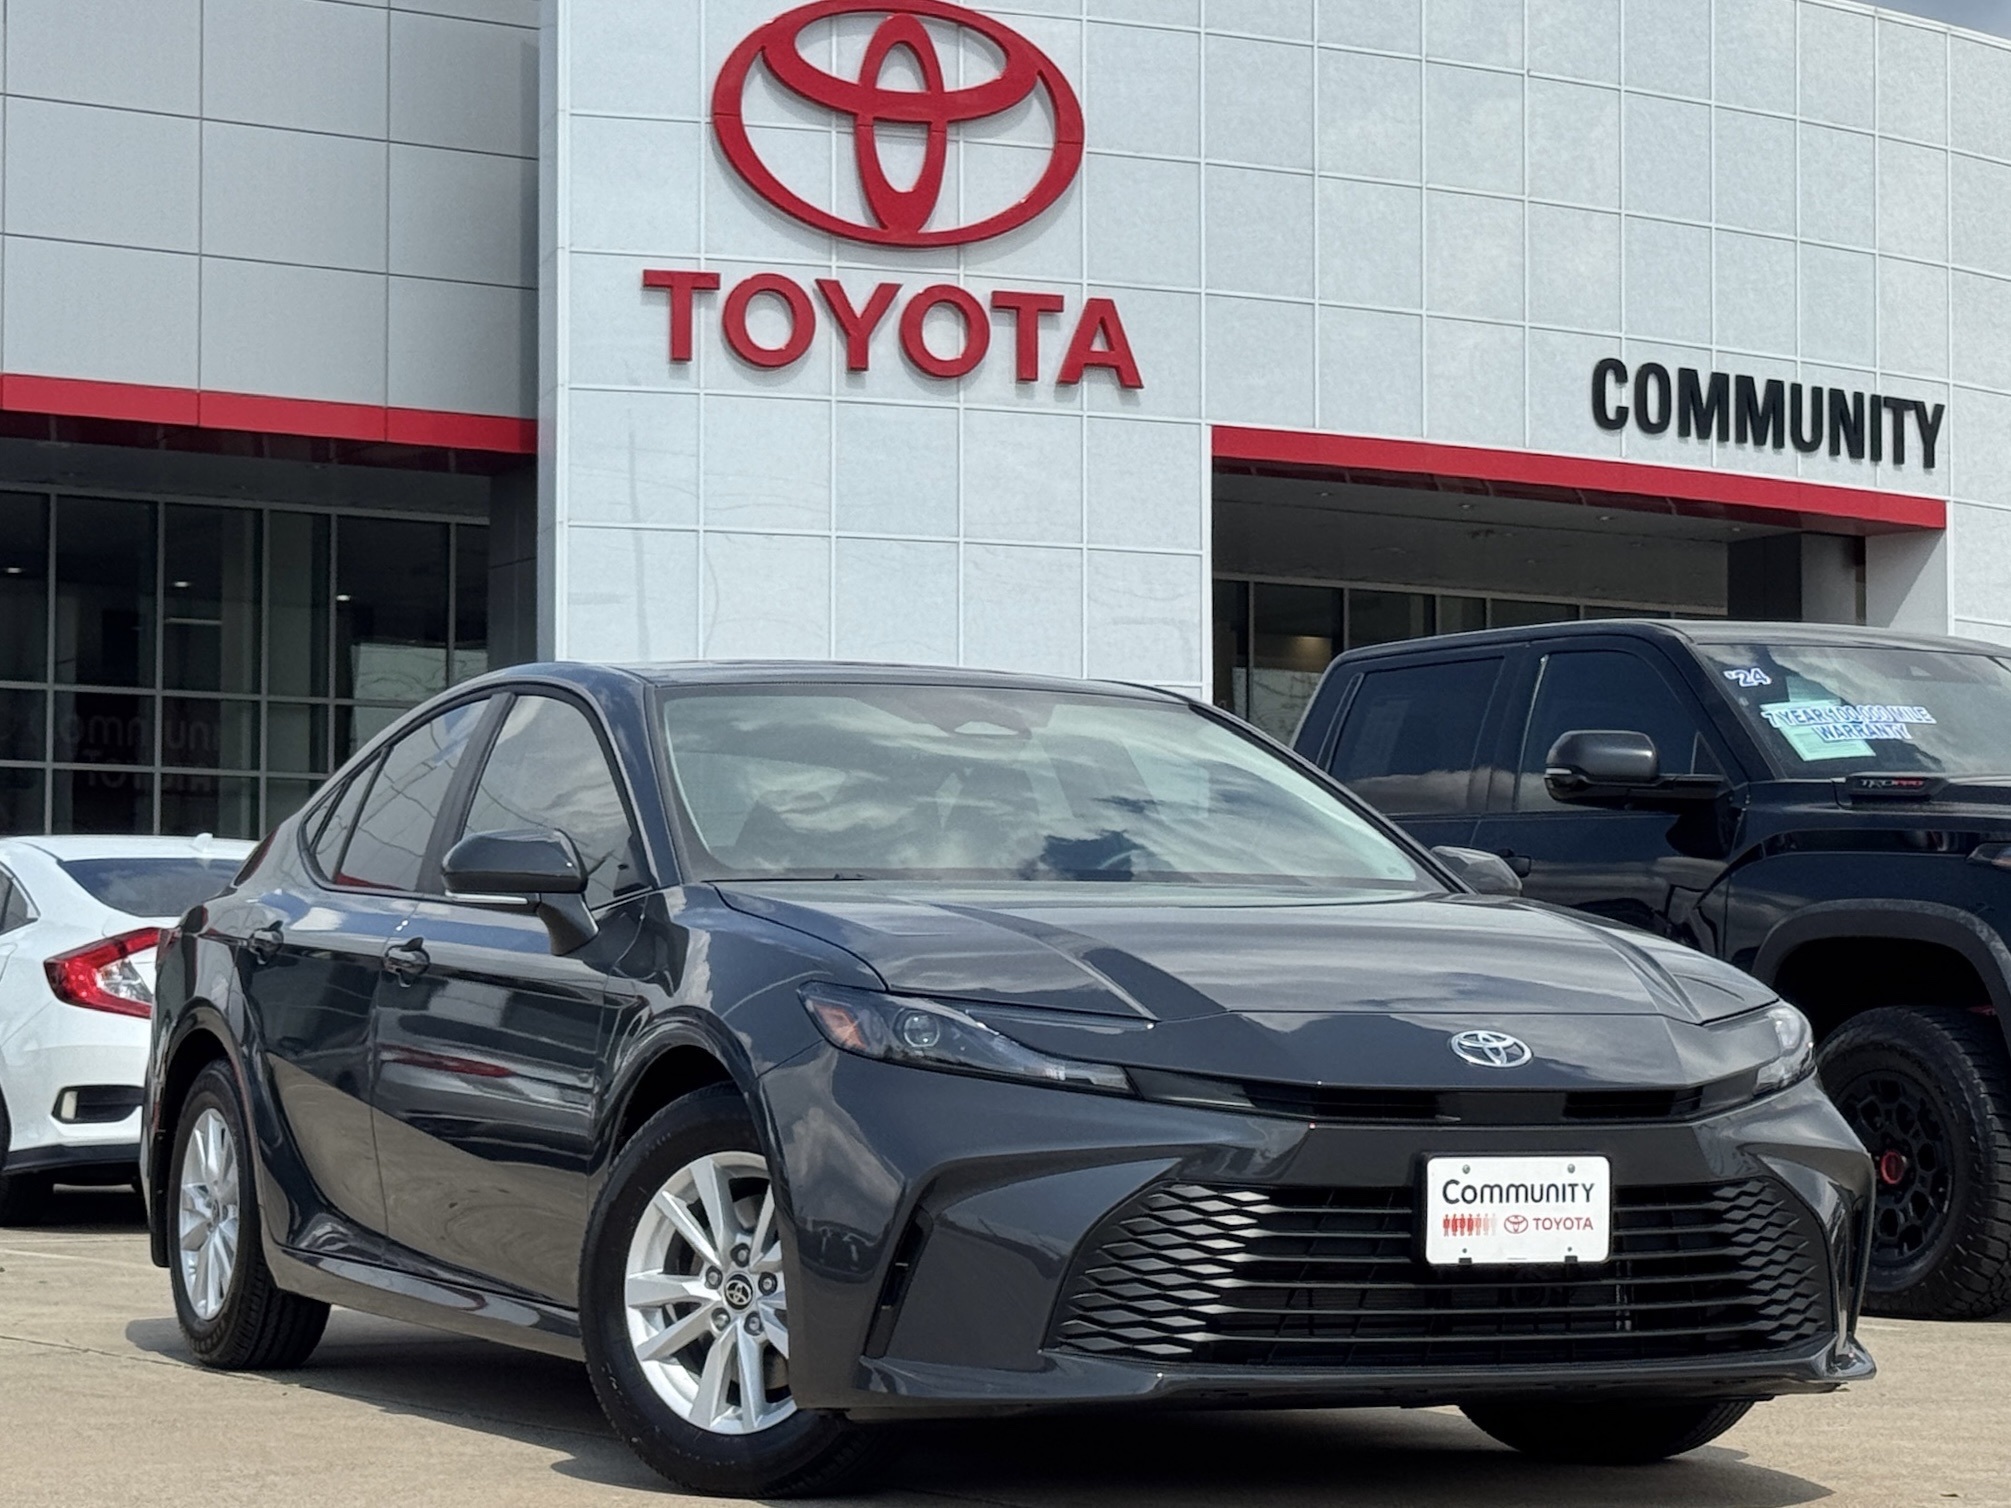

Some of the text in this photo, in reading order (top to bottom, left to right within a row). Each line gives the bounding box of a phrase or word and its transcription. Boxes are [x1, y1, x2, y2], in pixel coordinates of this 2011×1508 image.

[643, 269, 1144, 389] TOYOTA
[1591, 357, 1945, 469] COMMUNITY
[1762, 711, 1779, 727] 7
[1775, 708, 1828, 724] YEAR
[1887, 706, 1936, 723] MILE
[1814, 724, 1911, 741] WARRANTY
[1533, 1217, 1594, 1231] TOYOTA
